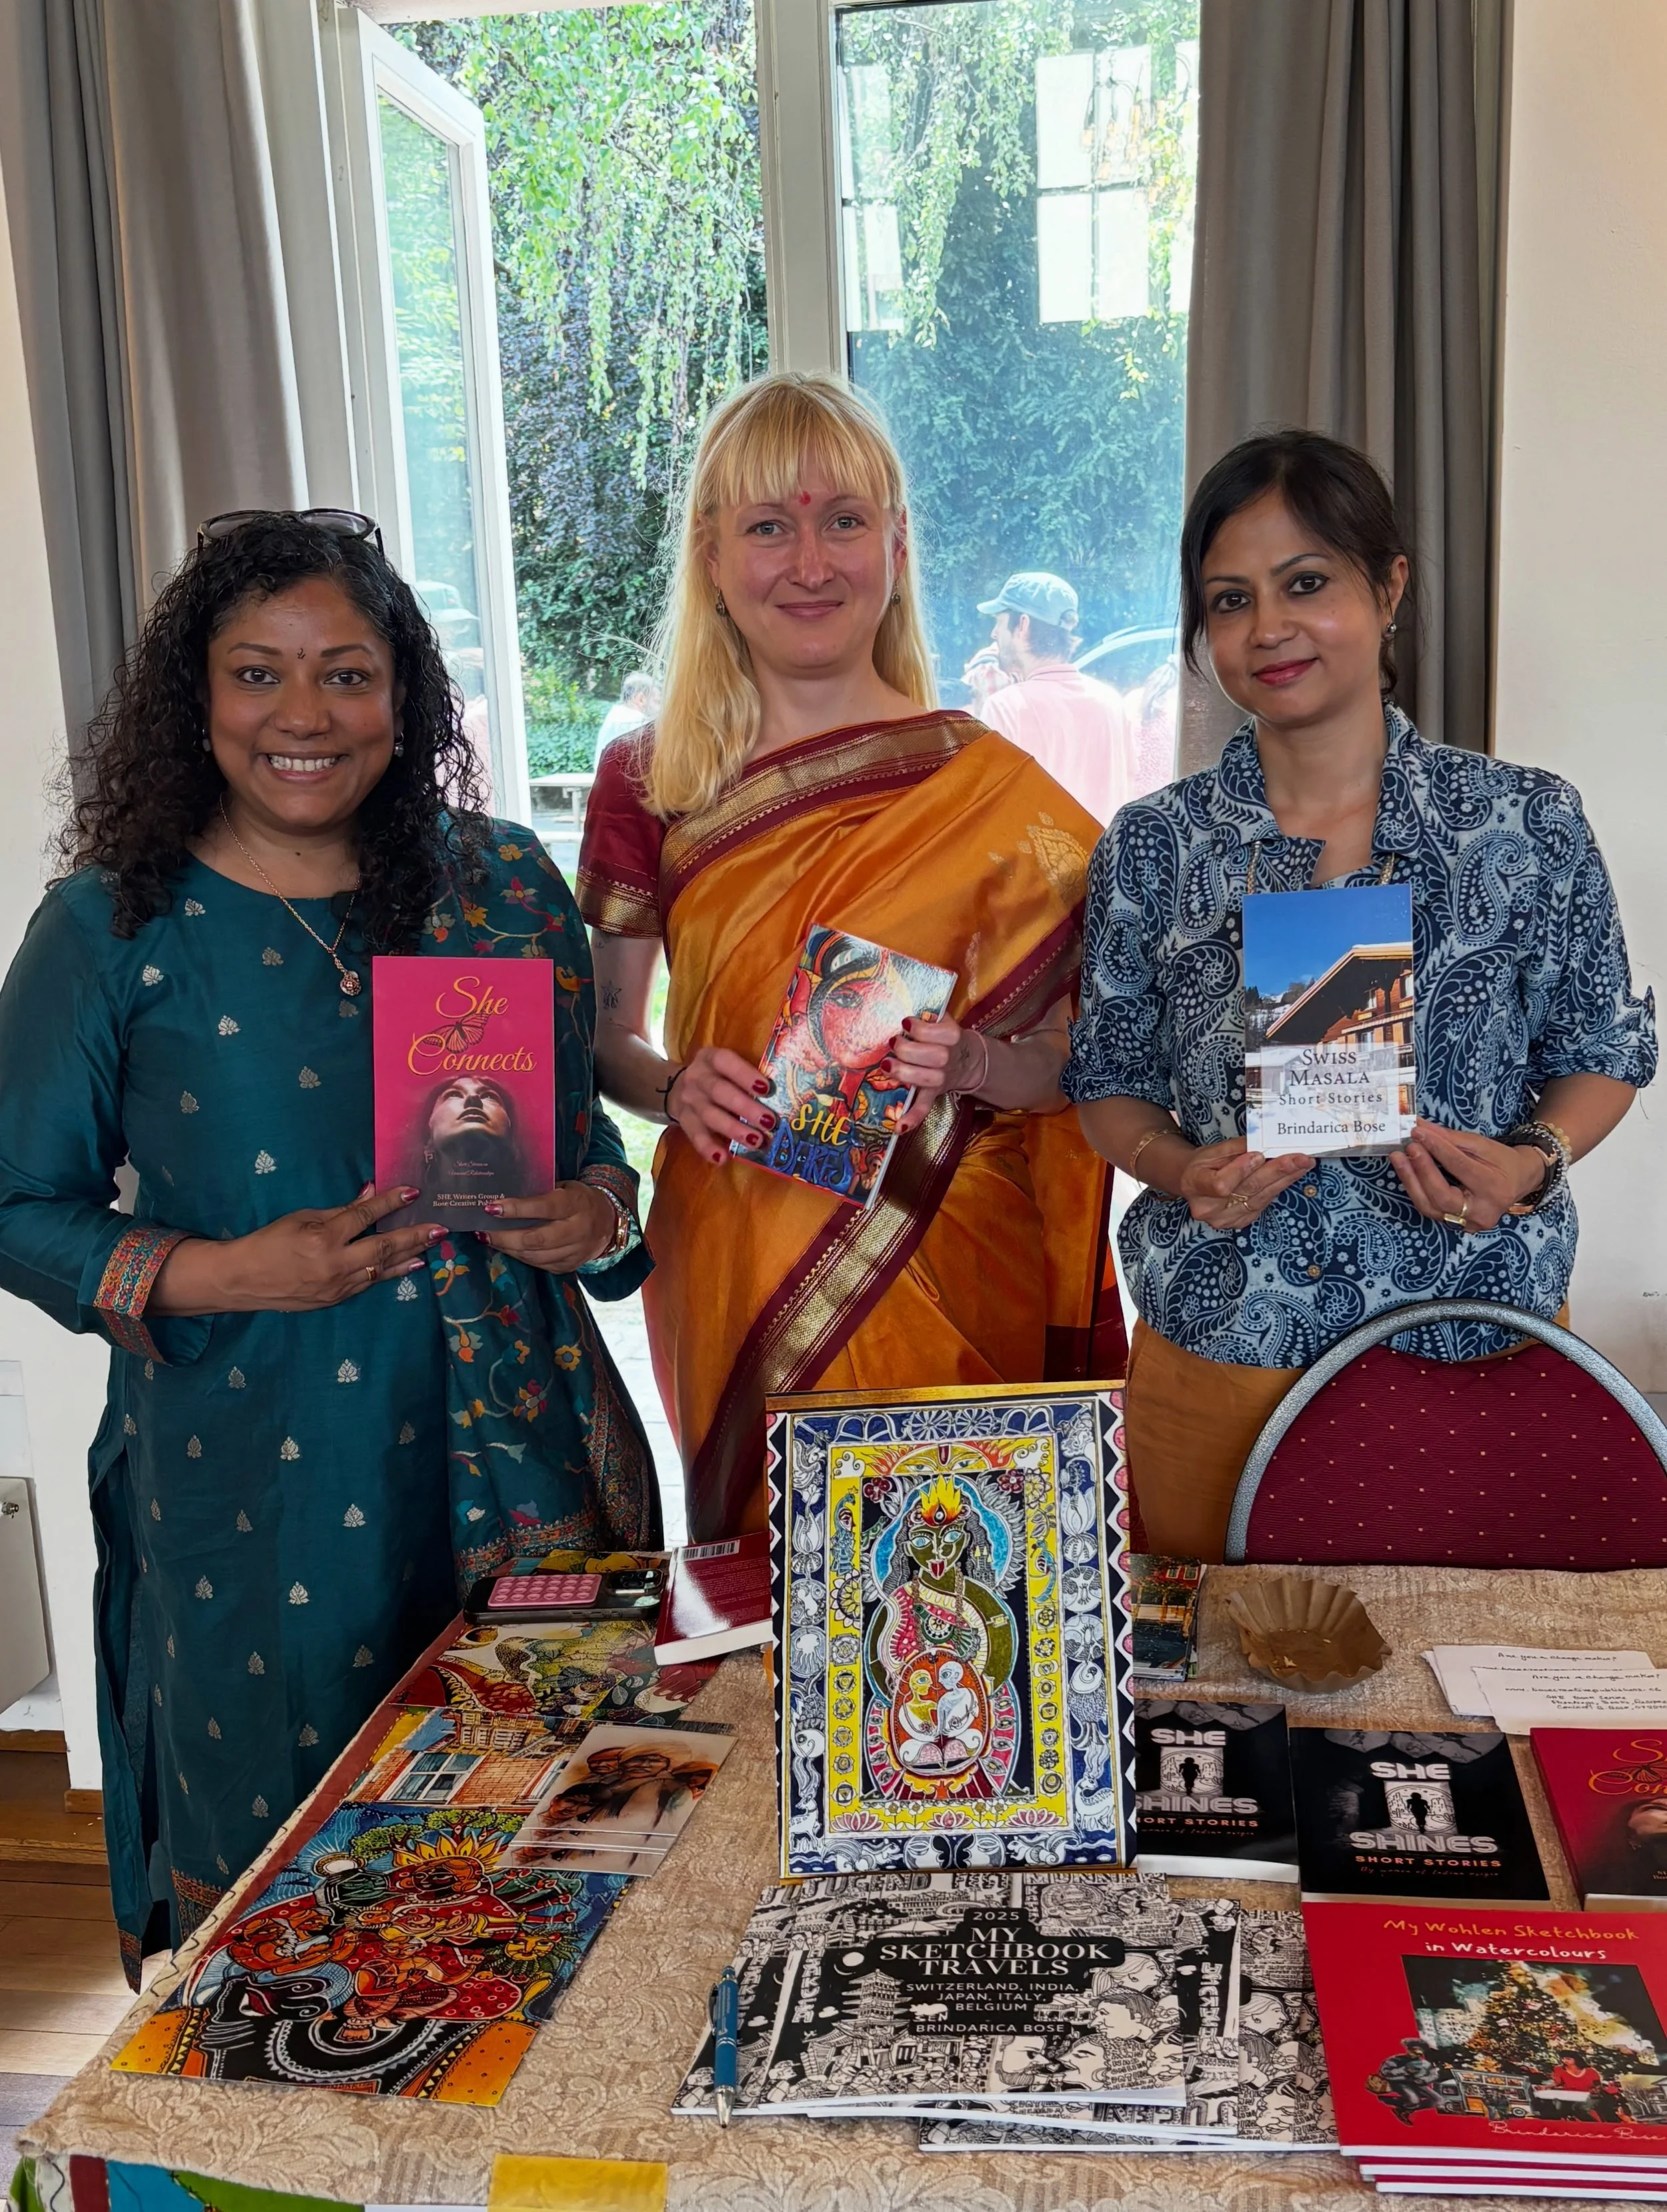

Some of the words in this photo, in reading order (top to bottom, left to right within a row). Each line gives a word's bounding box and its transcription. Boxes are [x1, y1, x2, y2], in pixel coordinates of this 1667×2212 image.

[435, 975, 509, 1019] She
[407, 1032, 537, 1076] Connects
[1302, 1049, 1357, 1066] SWISS
[1290, 1069, 1370, 1086] MASALA
[1280, 1094, 1322, 1105] Short
[1328, 1092, 1383, 1104] Stories
[791, 1103, 852, 1146] SHE
[1278, 1121, 1349, 1135] Brindarica
[1353, 1120, 1386, 1133] Bose
[1151, 1727, 1227, 1747] SHE
[1370, 1761, 1452, 1780] SHE
[1135, 1795, 1258, 1814] HINES
[1184, 1818, 1258, 1827] STORIES
[1350, 1832, 1498, 1853] SHINES
[1355, 1855, 1414, 1865] SHORT
[1424, 1859, 1502, 1867] STORIES
[972, 1911, 1020, 1921] 2025
[970, 1927, 1022, 1943] MY
[1384, 1919, 1420, 1936] My
[1425, 1921, 1507, 1937] Wohlen
[1514, 1924, 1640, 1940] Sketchbook
[880, 1943, 1112, 1961] SKETCHBOOK
[1426, 1941, 1446, 1953] in
[1450, 1941, 1607, 1960] Watercolours
[918, 1959, 1070, 1975] TRAVELS
[906, 1983, 1023, 1992] SWITZERLAND,
[999, 1993, 1046, 2001] ITALY,
[955, 2003, 1028, 2011] BELGIUM
[916, 2024, 1022, 2033] BRINDARICA
[1024, 2024, 1065, 2033] BOSE
